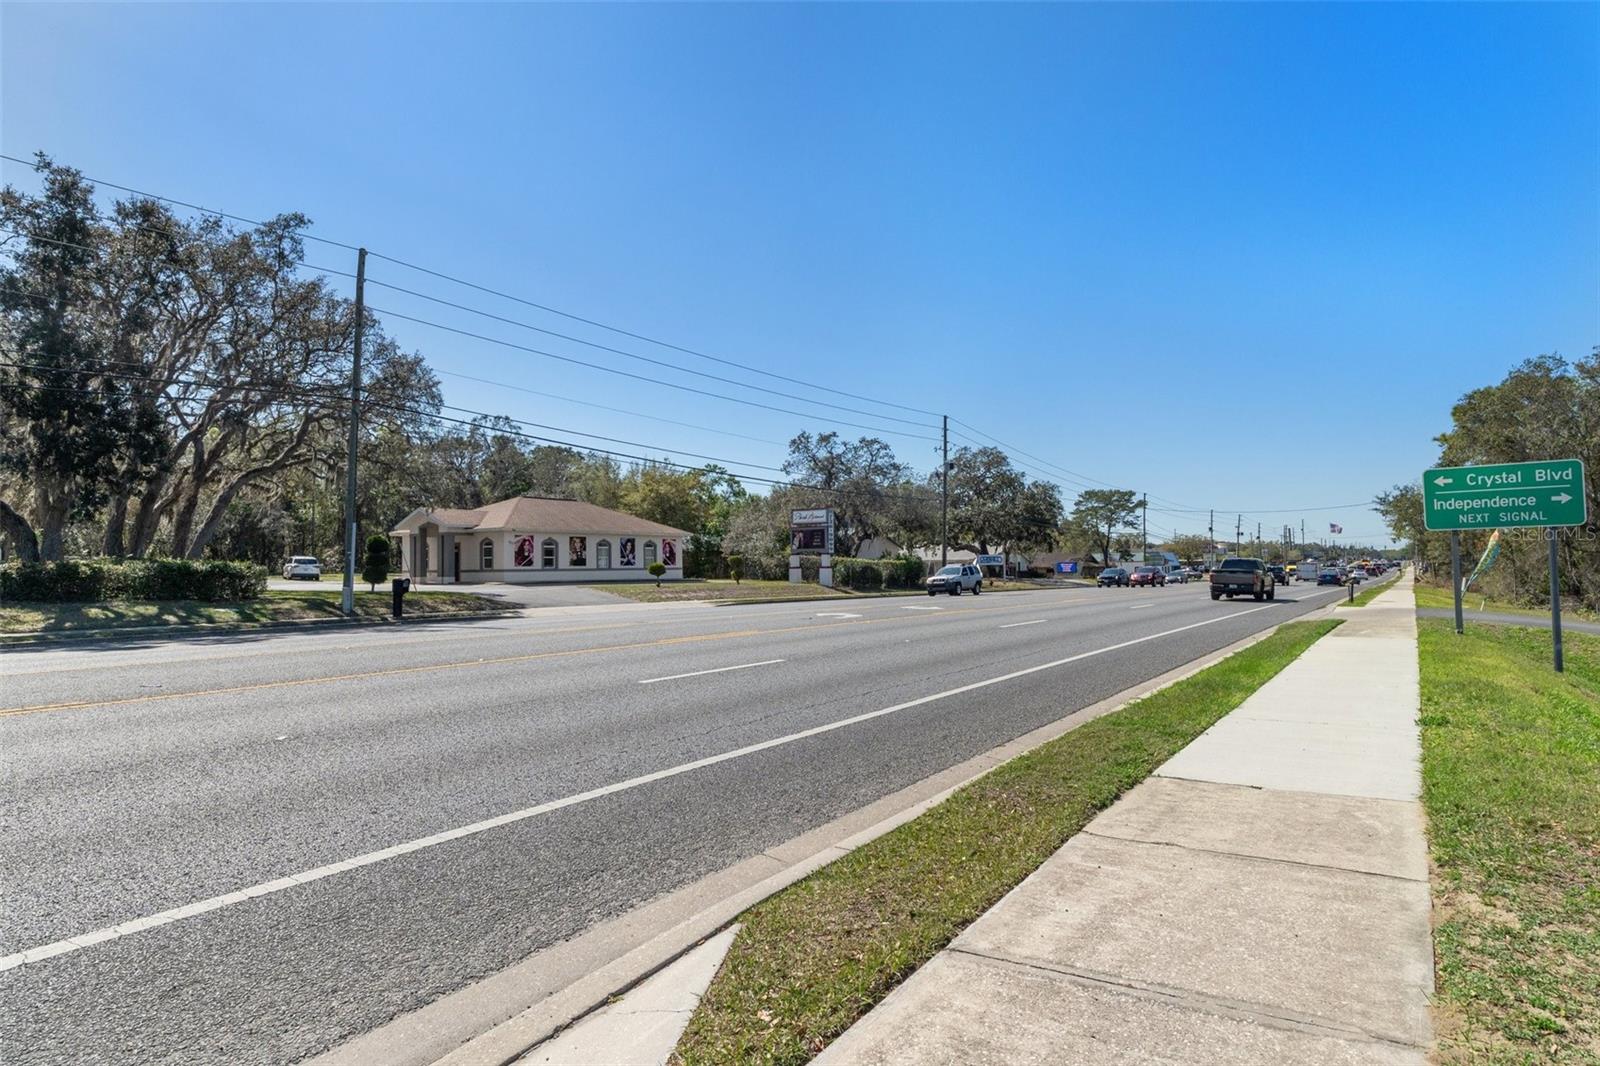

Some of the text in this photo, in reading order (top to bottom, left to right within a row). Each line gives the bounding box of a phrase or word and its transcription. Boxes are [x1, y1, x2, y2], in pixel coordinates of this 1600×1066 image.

[1466, 467, 1573, 487] Crystal Blvd
[1433, 495, 1537, 511] Independence
[1458, 511, 1548, 523] NEXT SIGNAL
